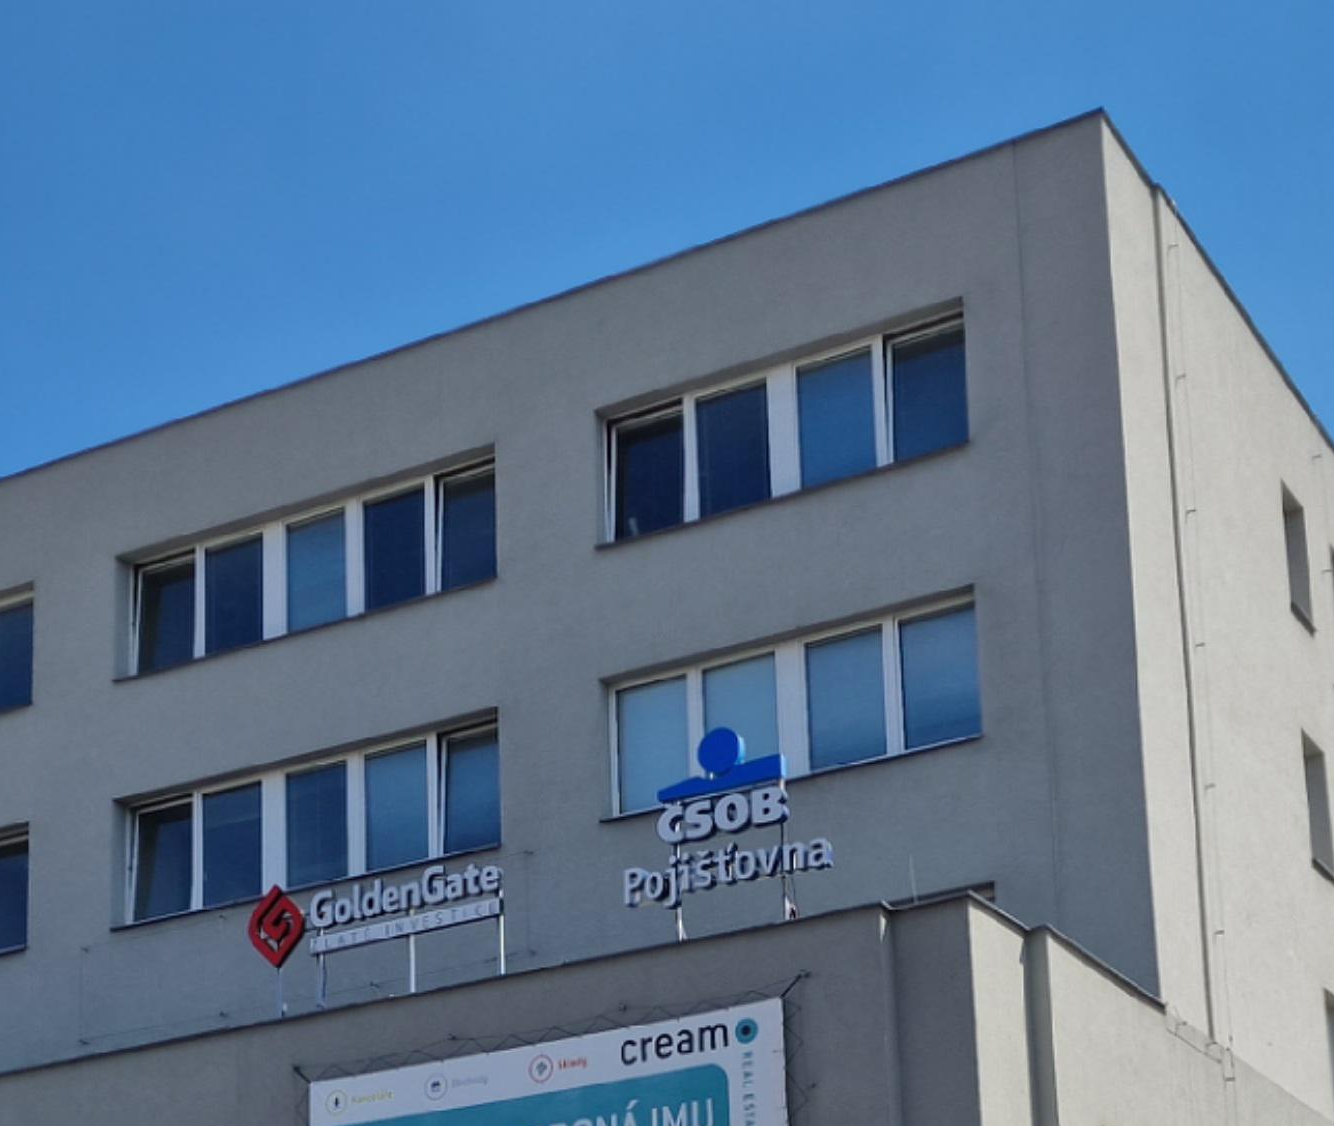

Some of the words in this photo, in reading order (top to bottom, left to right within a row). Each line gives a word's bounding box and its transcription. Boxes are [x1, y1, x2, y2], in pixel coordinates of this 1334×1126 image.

[657, 785, 788, 844] ČSOB
[310, 863, 501, 928] GoldenGate
[624, 837, 835, 908] Pojišťovna
[620, 1022, 729, 1066] cream
